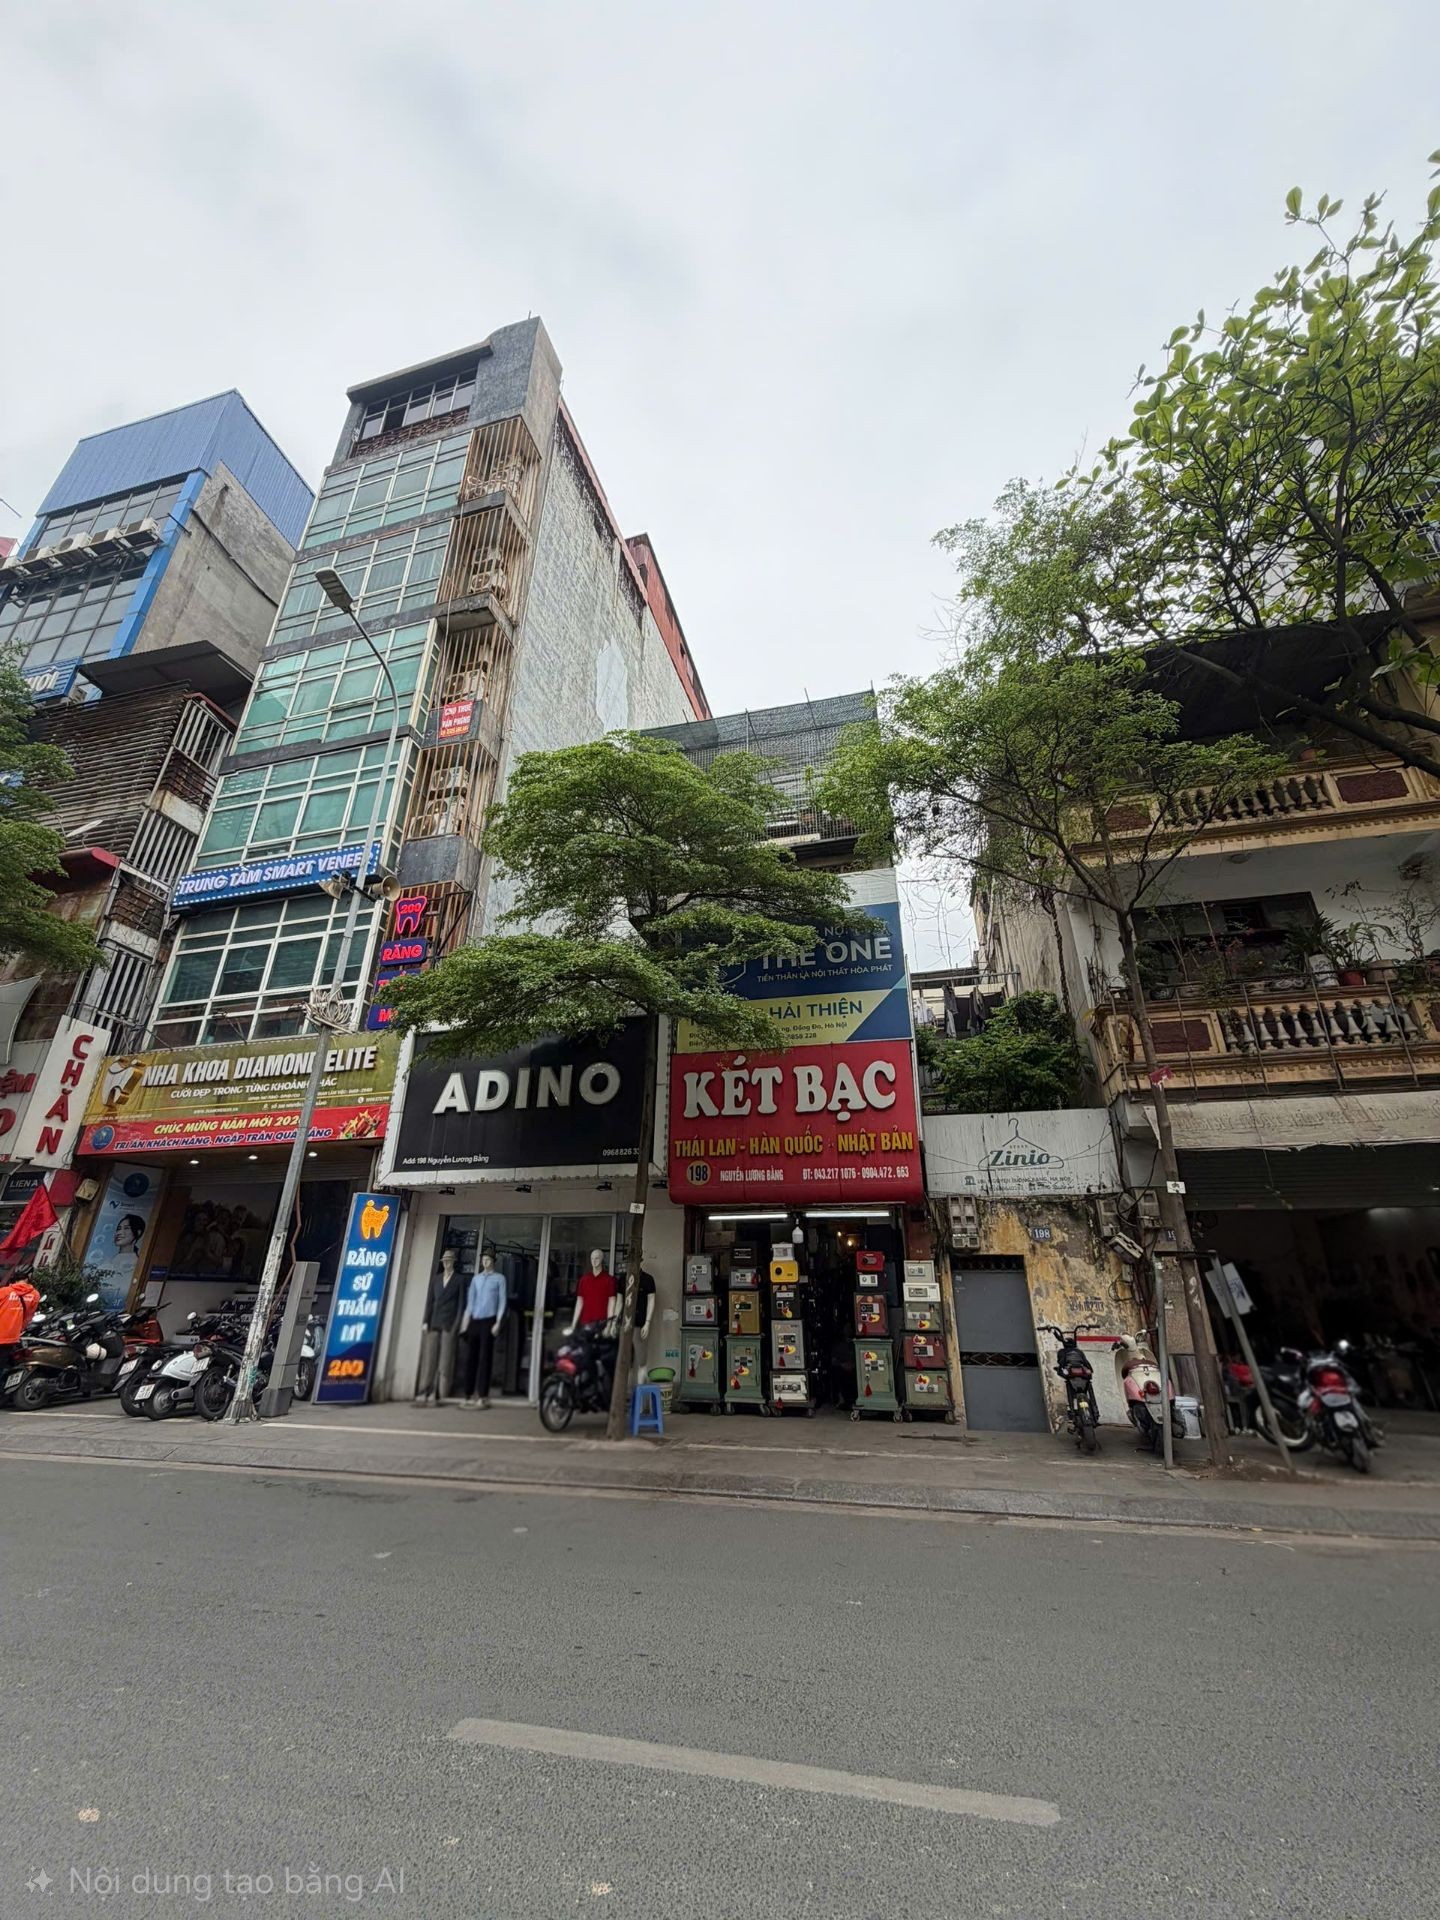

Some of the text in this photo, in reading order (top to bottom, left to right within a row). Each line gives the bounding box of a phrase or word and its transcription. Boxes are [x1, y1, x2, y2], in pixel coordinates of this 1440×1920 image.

[179, 875, 229, 895] TRUNG
[229, 867, 263, 887] TÂM
[263, 859, 315, 881] SMART
[400, 902, 422, 914] 200
[383, 944, 423, 961] RĂNG
[826, 936, 893, 964] ONE
[850, 963, 870, 975] HÒA
[871, 961, 894, 973] PHÁT
[769, 996, 863, 1019] HẢI THIỆN
[141, 1063, 179, 1087] NHA
[182, 1058, 231, 1083] KHOA
[324, 1045, 377, 1072] ELITE
[0, 1069, 36, 1099] ỆM
[193, 1087, 212, 1099] ĐẸP
[213, 1085, 244, 1096] TRONG
[245, 1080, 270, 1093] TỪNG
[432, 1062, 621, 1114] ADINO
[683, 1055, 897, 1121] KÉT BẠC
[153, 1113, 301, 1135] CHÚC MỪNG NĂM MỚI 202
[114, 1142, 131, 1151] TRI
[146, 1135, 180, 1149] KHÁCH
[215, 1131, 245, 1146] NGẬP
[246, 1129, 273, 1142] TRÀN
[308, 1125, 333, 1140] ẶNG
[675, 1134, 705, 1157] THÁI
[709, 1138, 736, 1156] LAN
[750, 1131, 780, 1154] HÀN
[784, 1125, 823, 1154] QUỐC
[837, 1127, 876, 1156] NHẬT
[881, 1124, 913, 1150] BẢN
[427, 1154, 451, 1166] Nguyễn
[451, 1155, 472, 1165] Lương
[473, 1153, 489, 1164] Bằng
[989, 1150, 1050, 1167] Zinio
[688, 1164, 709, 1182] 198
[720, 1165, 745, 1181] NGUYỄN
[745, 1167, 766, 1181] LƯƠNG
[766, 1165, 784, 1181] BẰNG
[1034, 1228, 1050, 1239] 198
[346, 1247, 387, 1266] RĂNG
[352, 1271, 374, 1291] SỨ
[337, 1292, 378, 1317] THẨM
[340, 1322, 367, 1342] MỸ
